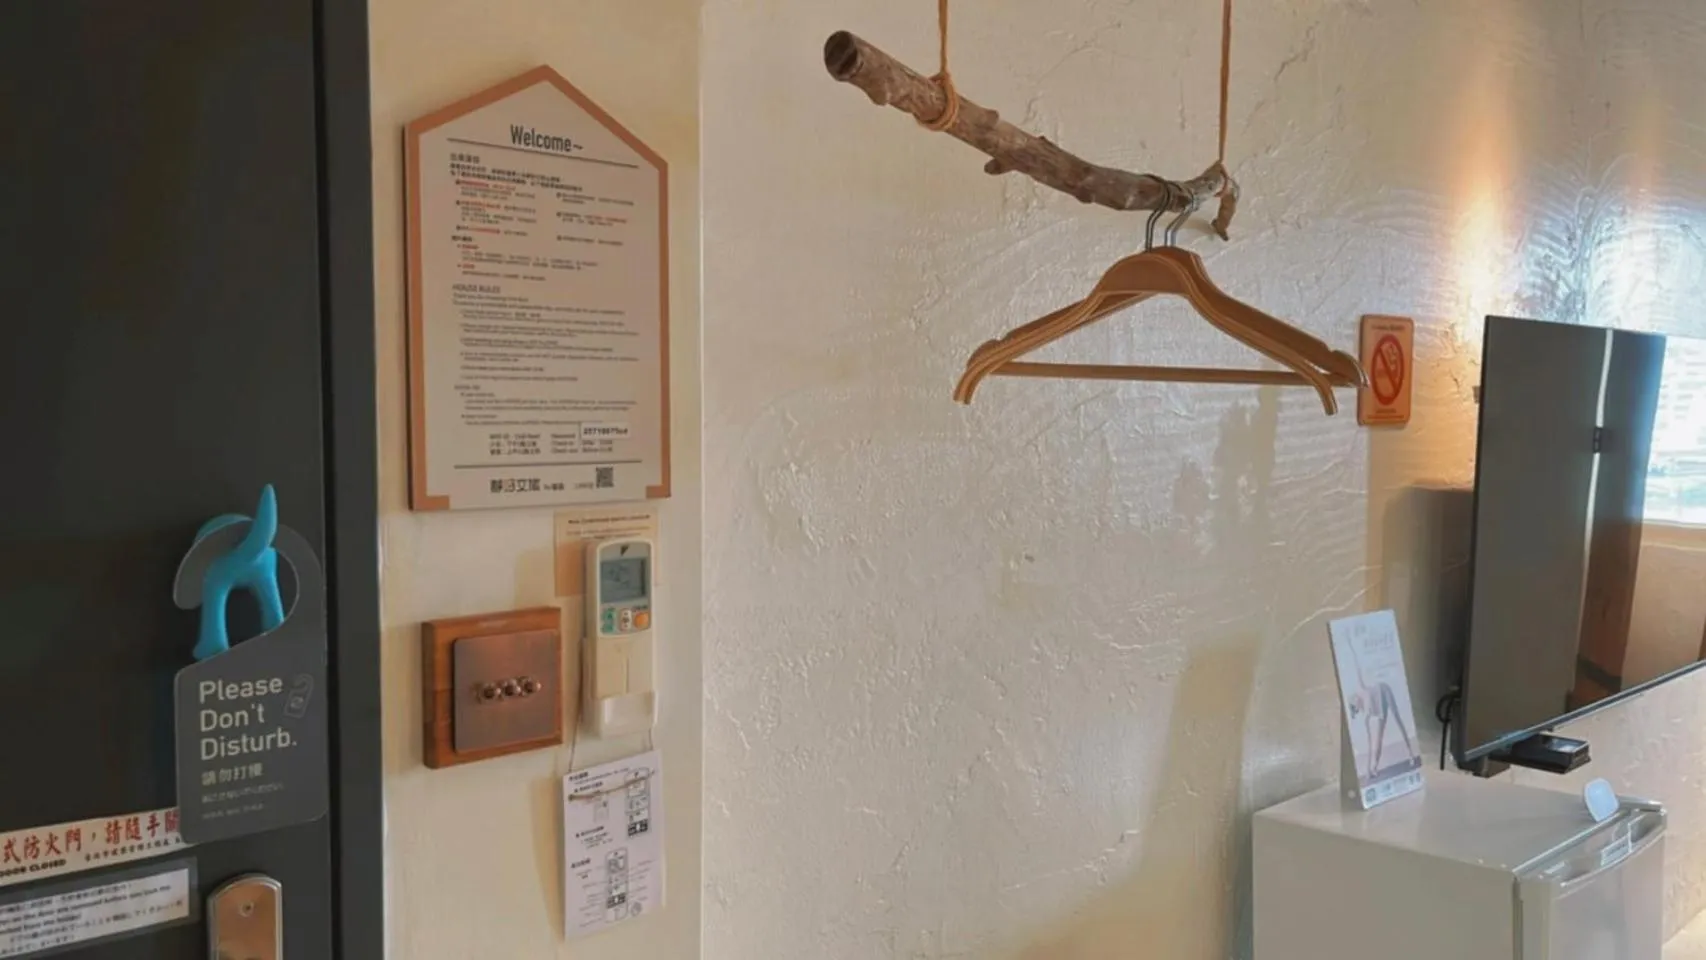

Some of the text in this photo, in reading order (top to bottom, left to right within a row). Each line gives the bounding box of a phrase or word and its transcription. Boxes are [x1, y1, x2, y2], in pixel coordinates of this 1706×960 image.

[200, 678, 283, 704] Please
[200, 703, 265, 732] Don't
[201, 727, 298, 760] Disturb.
[29, 859, 66, 872] CLOSED
